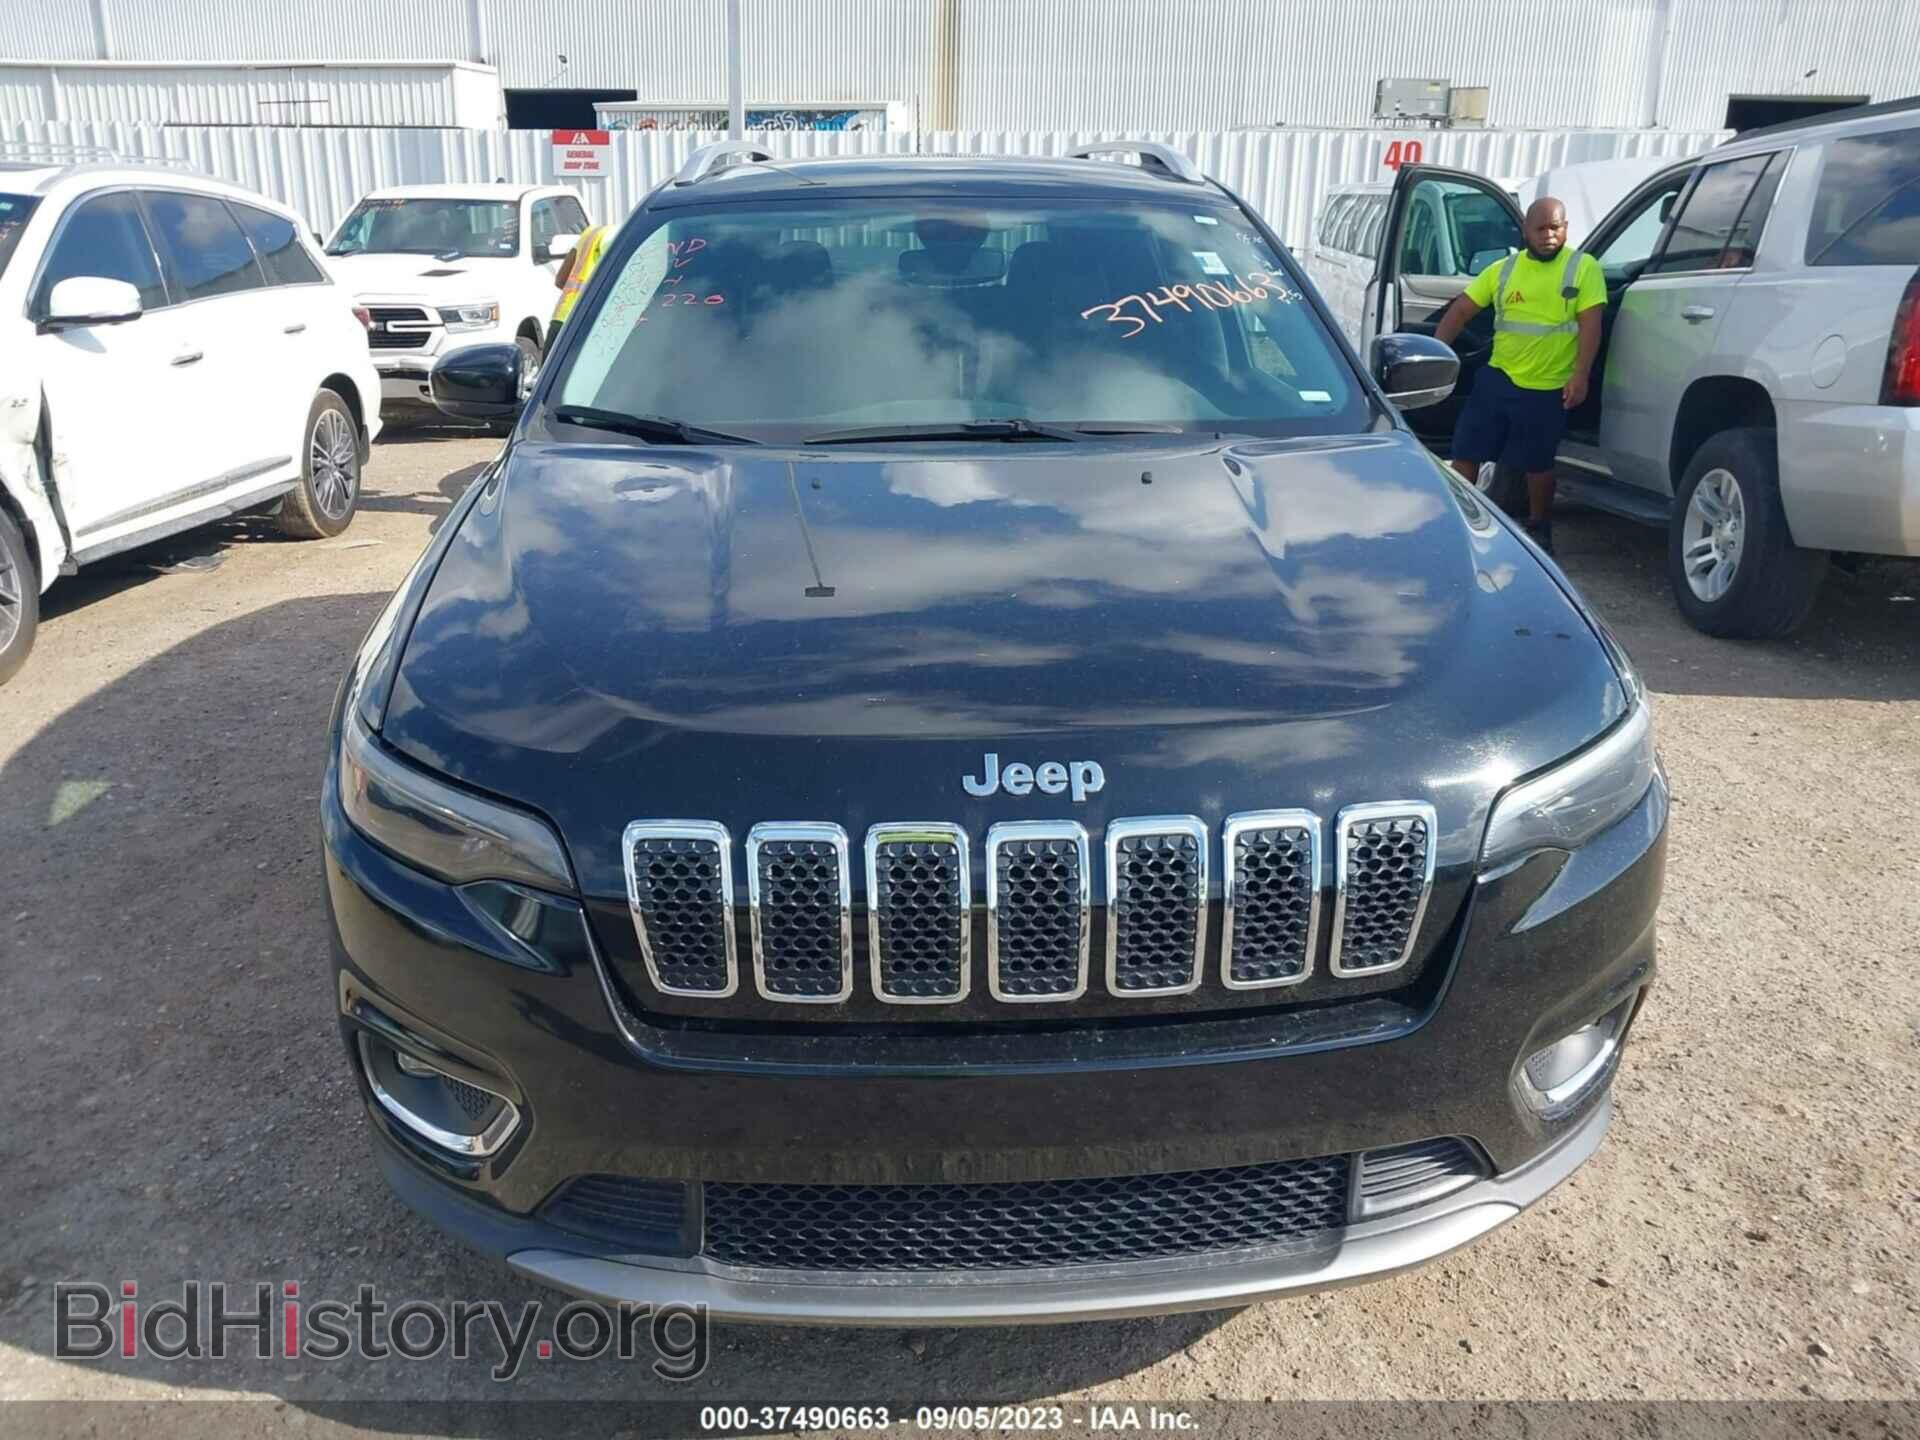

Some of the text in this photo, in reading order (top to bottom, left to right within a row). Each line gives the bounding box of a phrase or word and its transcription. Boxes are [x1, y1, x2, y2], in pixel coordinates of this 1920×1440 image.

[1383, 141, 1422, 170] 40
[1081, 272, 1287, 338] 37490663
[962, 753, 1106, 802] Jeep
